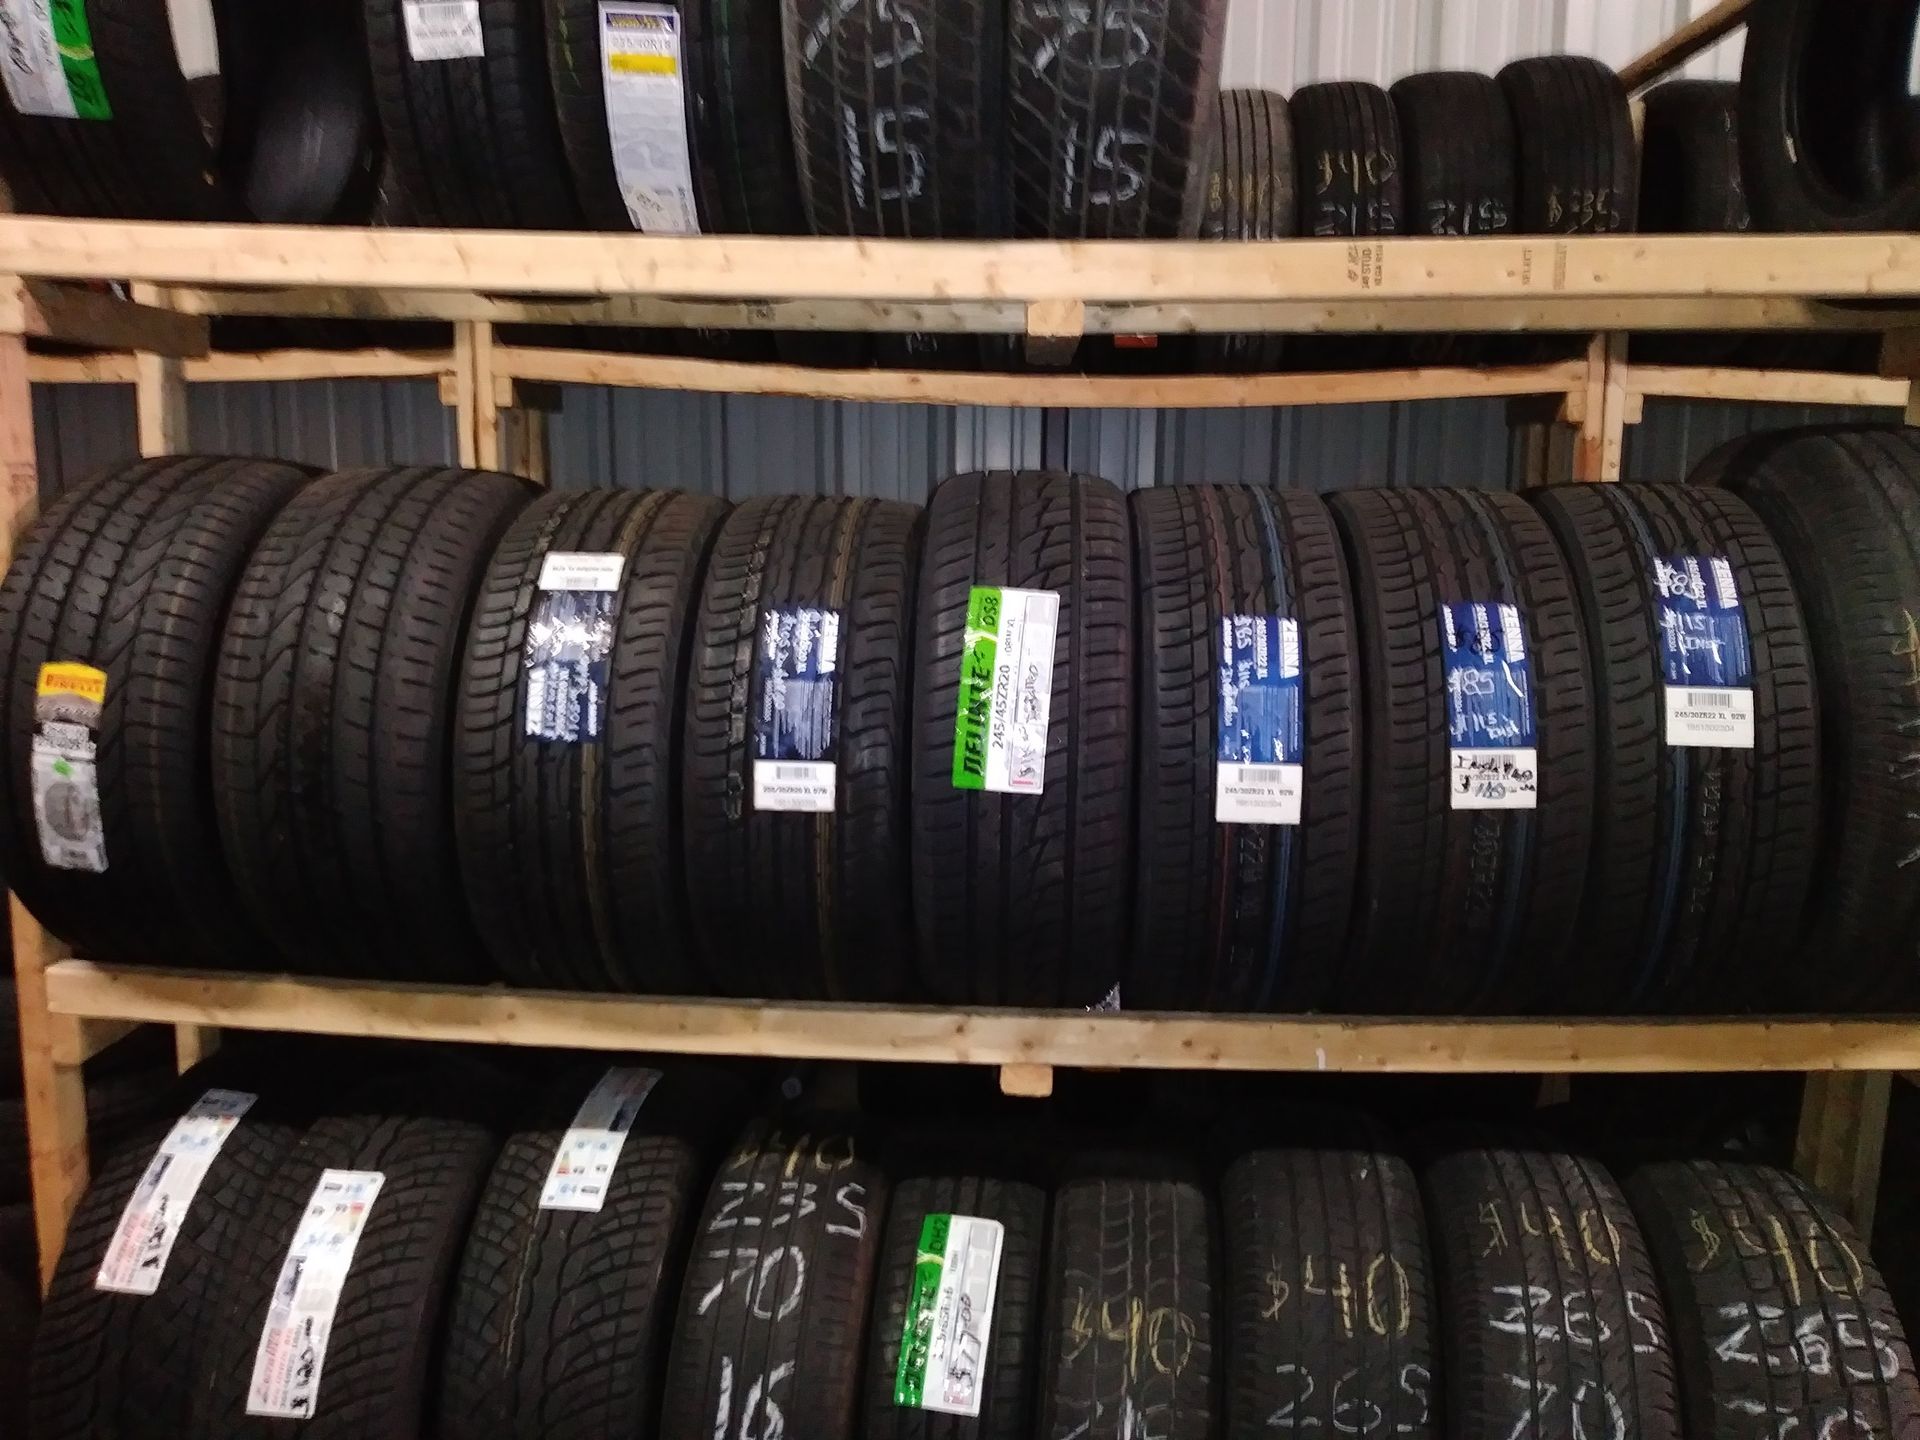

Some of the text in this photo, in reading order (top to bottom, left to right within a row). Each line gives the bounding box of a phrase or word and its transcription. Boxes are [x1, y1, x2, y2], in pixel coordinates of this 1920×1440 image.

[843, 104, 929, 208] 15
[1061, 123, 1154, 211] 15
[982, 596, 999, 627] DS8
[1712, 557, 1739, 609] ZENNA
[820, 610, 840, 674] ZENNA
[1281, 617, 1300, 679] ZENNA
[1500, 603, 1525, 663] ZENNA
[992, 664, 1010, 749] 245/45ZR20
[1447, 667, 1495, 697] $85
[708, 1182, 868, 1241] 235
[698, 1246, 805, 1321] 70
[1690, 1208, 1864, 1307] $40
[1261, 1252, 1411, 1339] $40
[1488, 1286, 1661, 1353] 265
[1061, 1285, 1197, 1379] $40
[714, 1356, 795, 1440] 16
[1266, 1363, 1430, 1434] 265
[1503, 1373, 1626, 1440] 70
